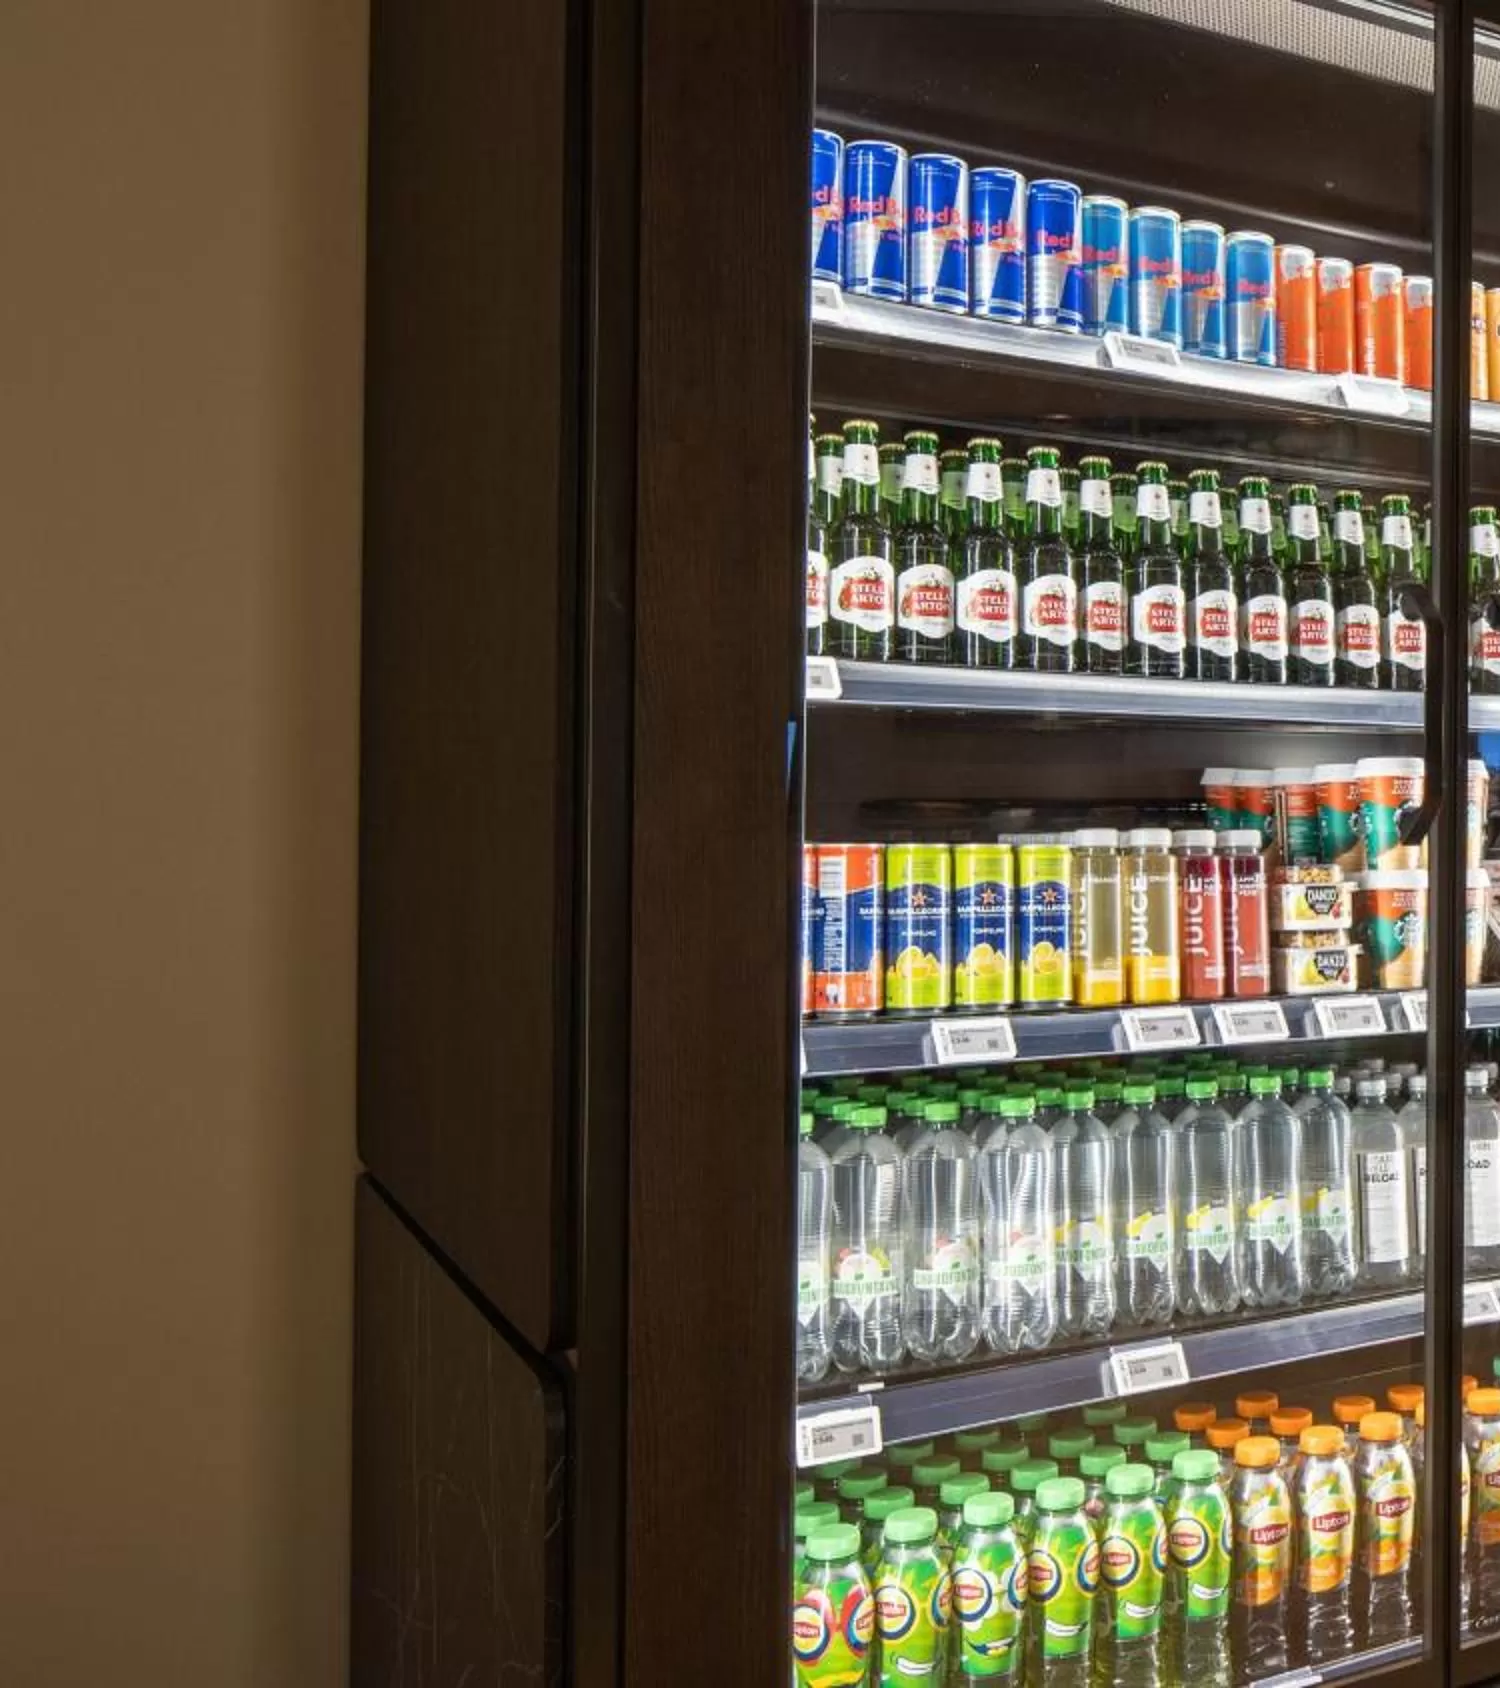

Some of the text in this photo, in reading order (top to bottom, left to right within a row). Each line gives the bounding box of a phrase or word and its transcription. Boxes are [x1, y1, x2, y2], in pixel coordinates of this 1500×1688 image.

[1185, 873, 1209, 957] JUICE
[1380, 1499, 1411, 1517] Lipton
[1315, 1512, 1350, 1531] Lipton
[1253, 1526, 1288, 1544] Lipton
